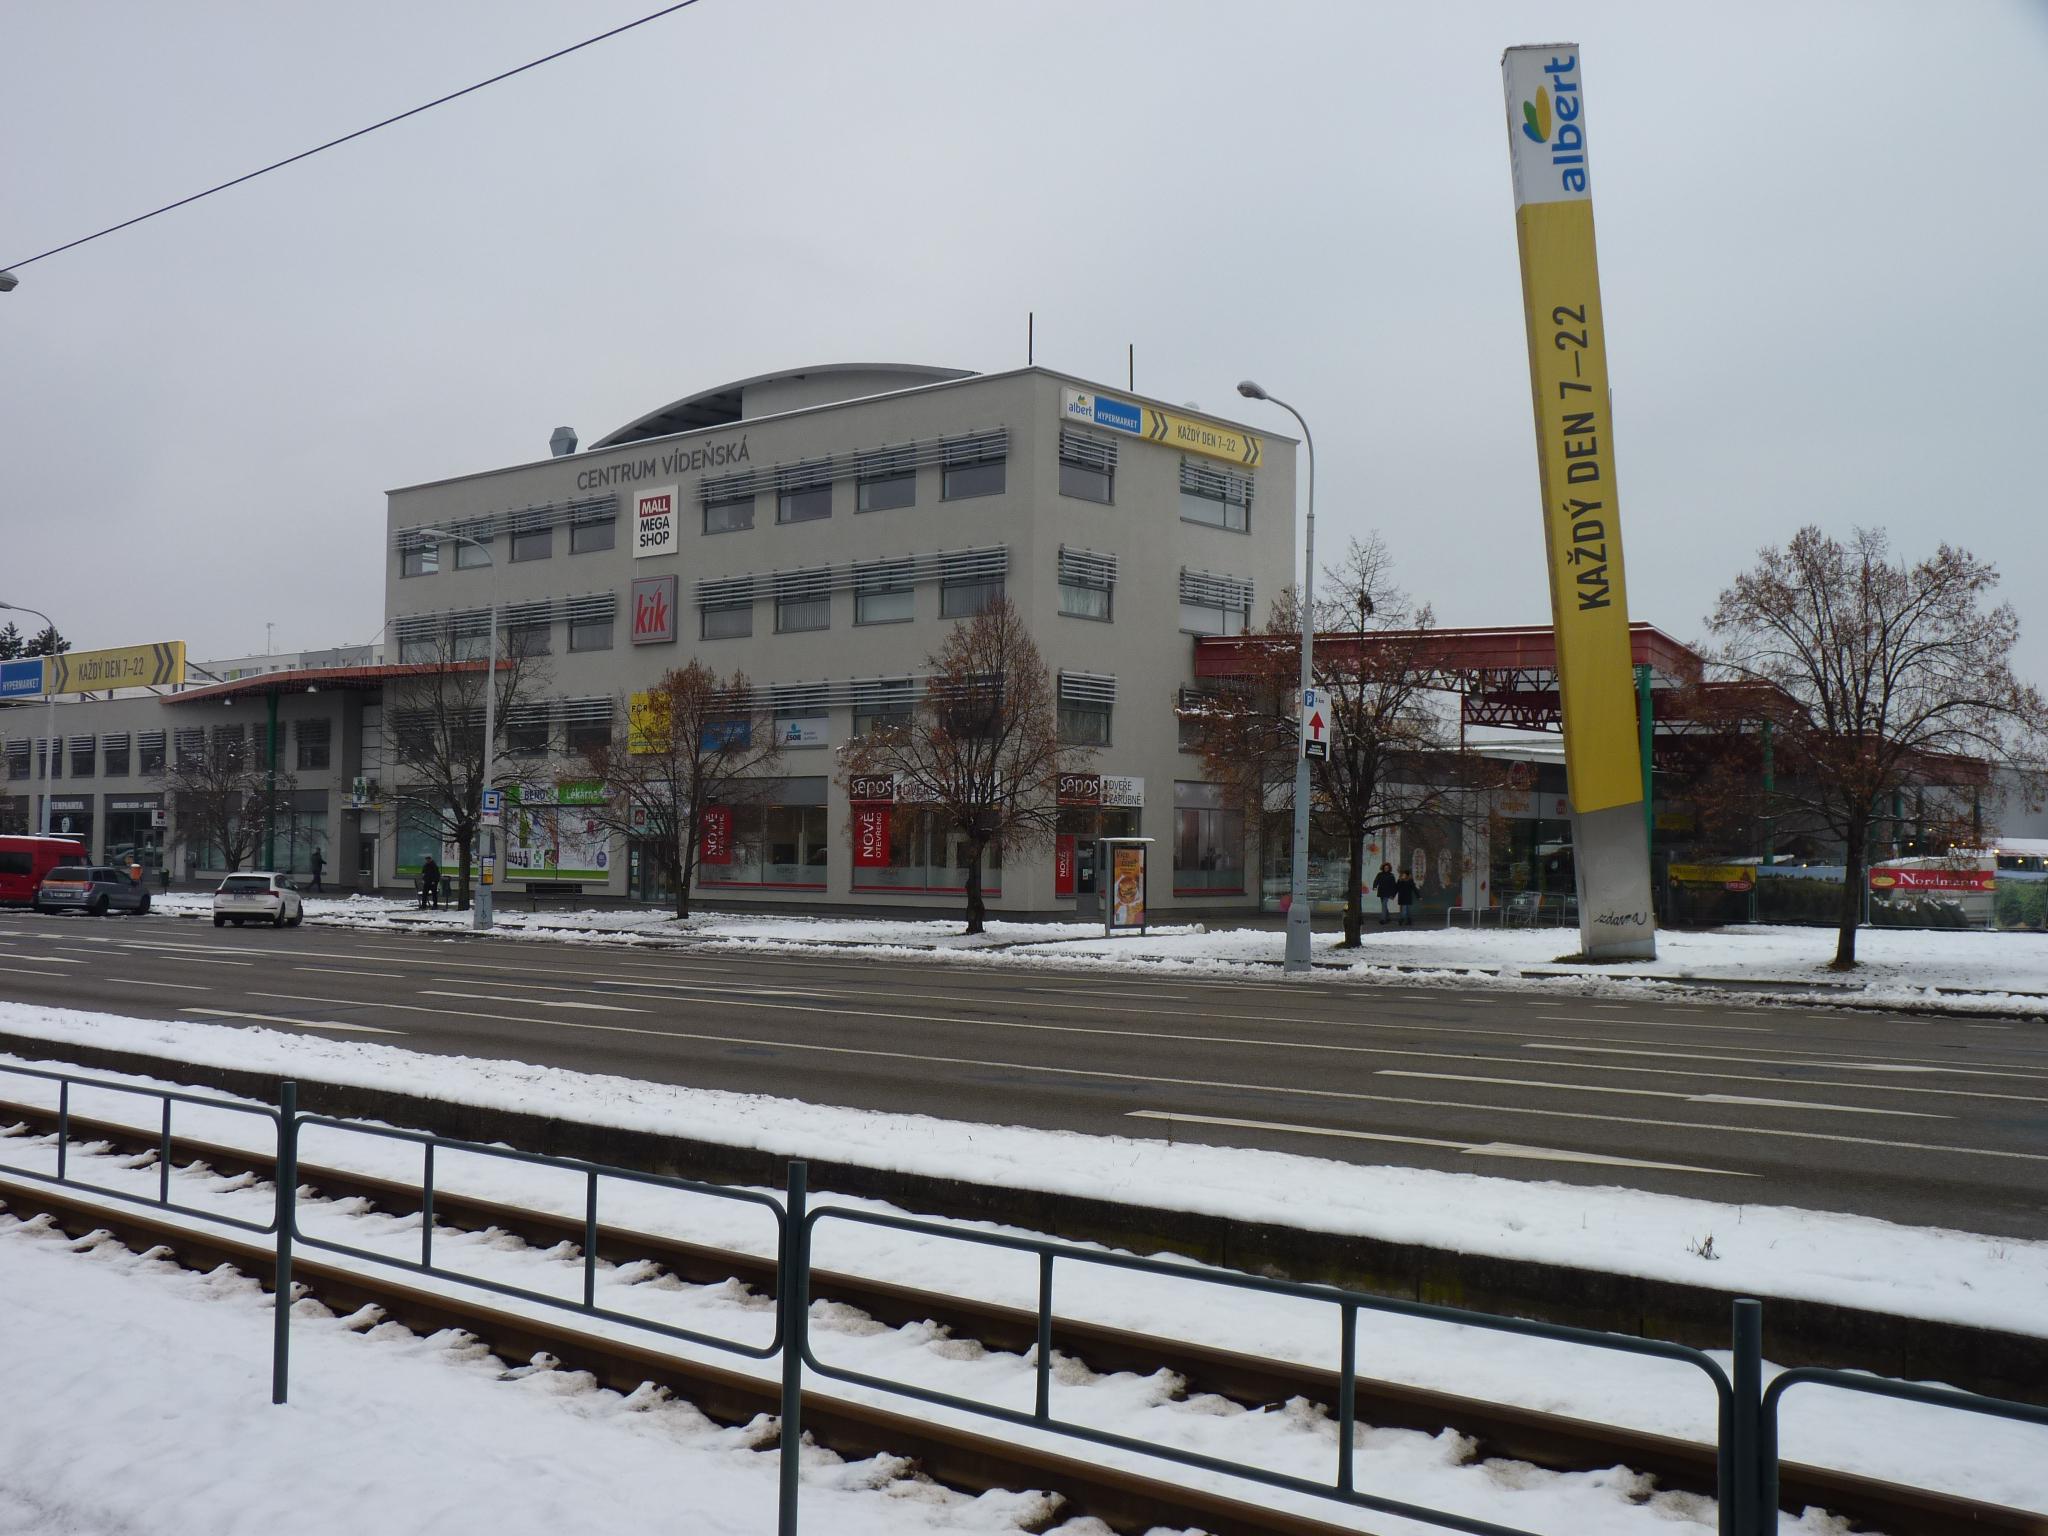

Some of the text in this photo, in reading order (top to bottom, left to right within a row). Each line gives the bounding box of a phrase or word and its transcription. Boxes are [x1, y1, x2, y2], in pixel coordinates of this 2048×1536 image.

[1543, 55, 1587, 193] albert
[1068, 401, 1092, 417] albert
[1097, 410, 1138, 429] HYPERMARKET
[1177, 424, 1200, 442] KAŽDÝ
[1202, 433, 1216, 446] DEN
[1561, 411, 1600, 485] DEN
[577, 434, 750, 490] CENTRUM VÍDEŇSKÁ
[641, 497, 669, 515] MALL
[640, 516, 670, 532] MEGA
[639, 531, 670, 547] SHOP
[1562, 498, 1611, 612] KAŽDÝ
[78, 658, 103, 681] KAŽDÝ
[105, 662, 121, 678] DEN
[2, 678, 40, 691] HYPERMARKET
[1108, 778, 1132, 791] DVEŘE
